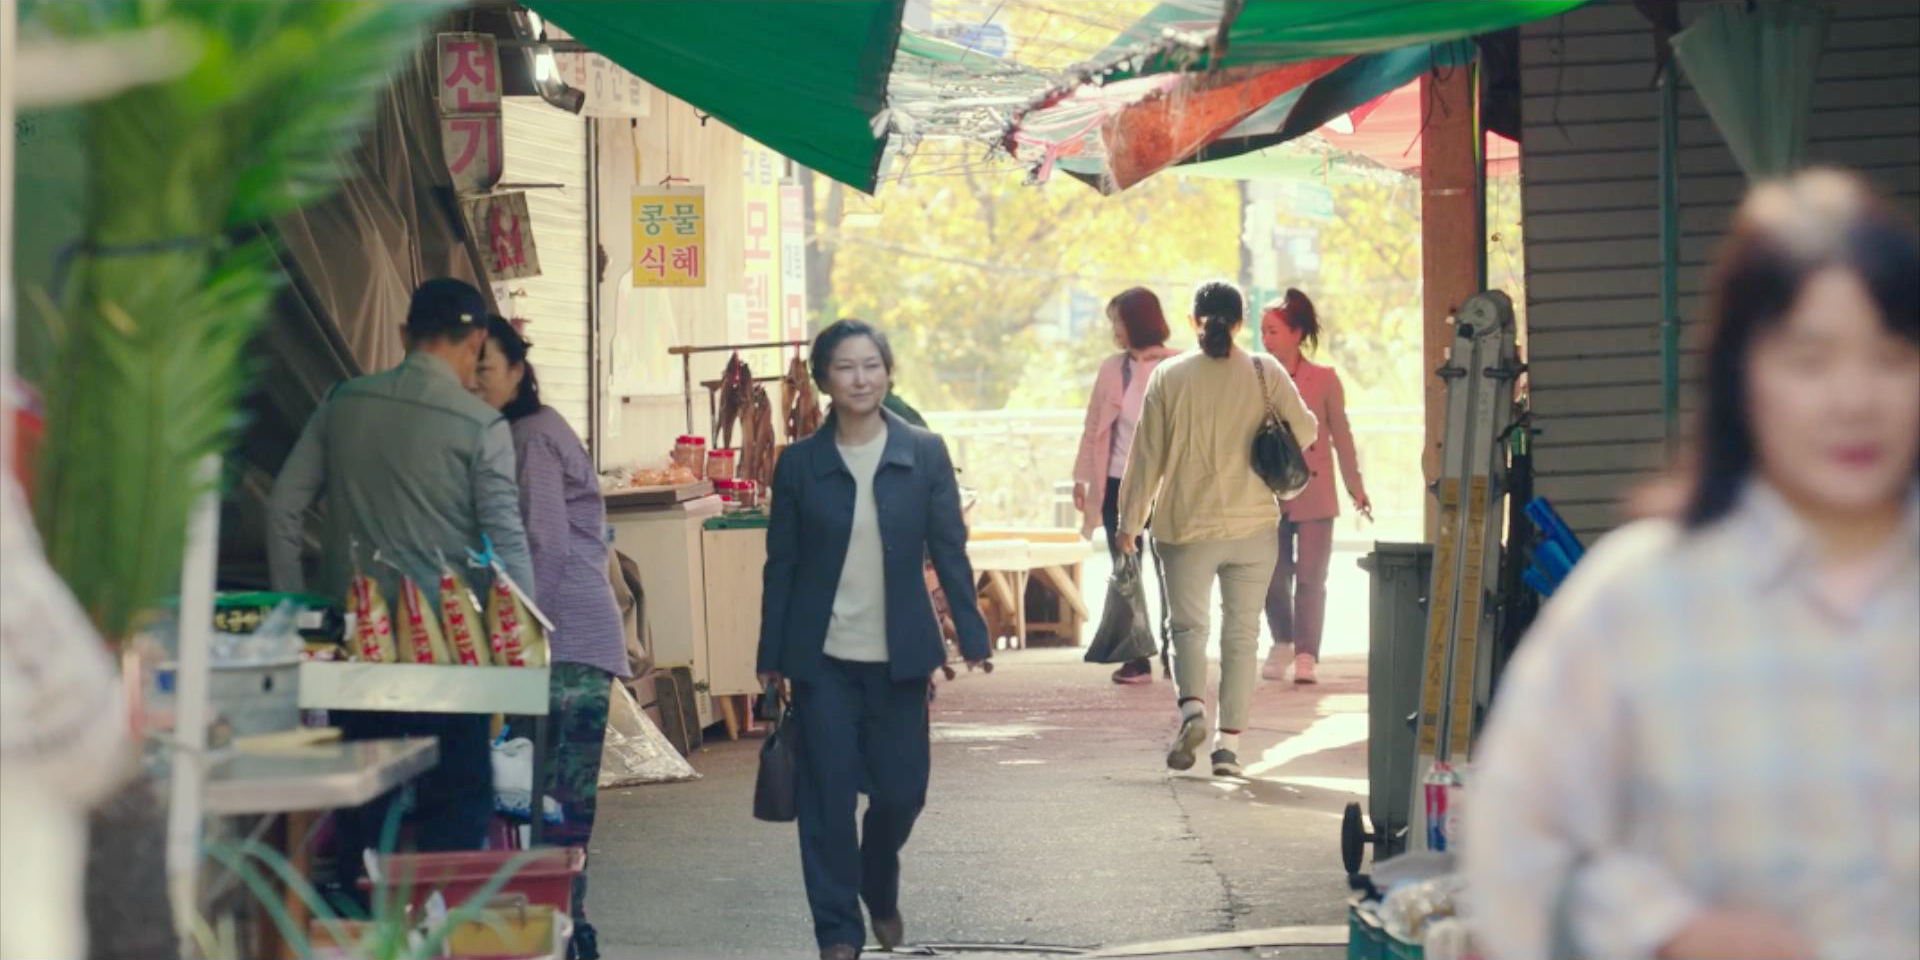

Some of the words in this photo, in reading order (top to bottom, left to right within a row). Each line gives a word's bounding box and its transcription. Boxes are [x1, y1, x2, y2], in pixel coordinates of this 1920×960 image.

[445, 41, 498, 175] 전기
[638, 204, 699, 235] 콩물
[640, 244, 698, 277] 식혜
[743, 201, 771, 339] 모텔
